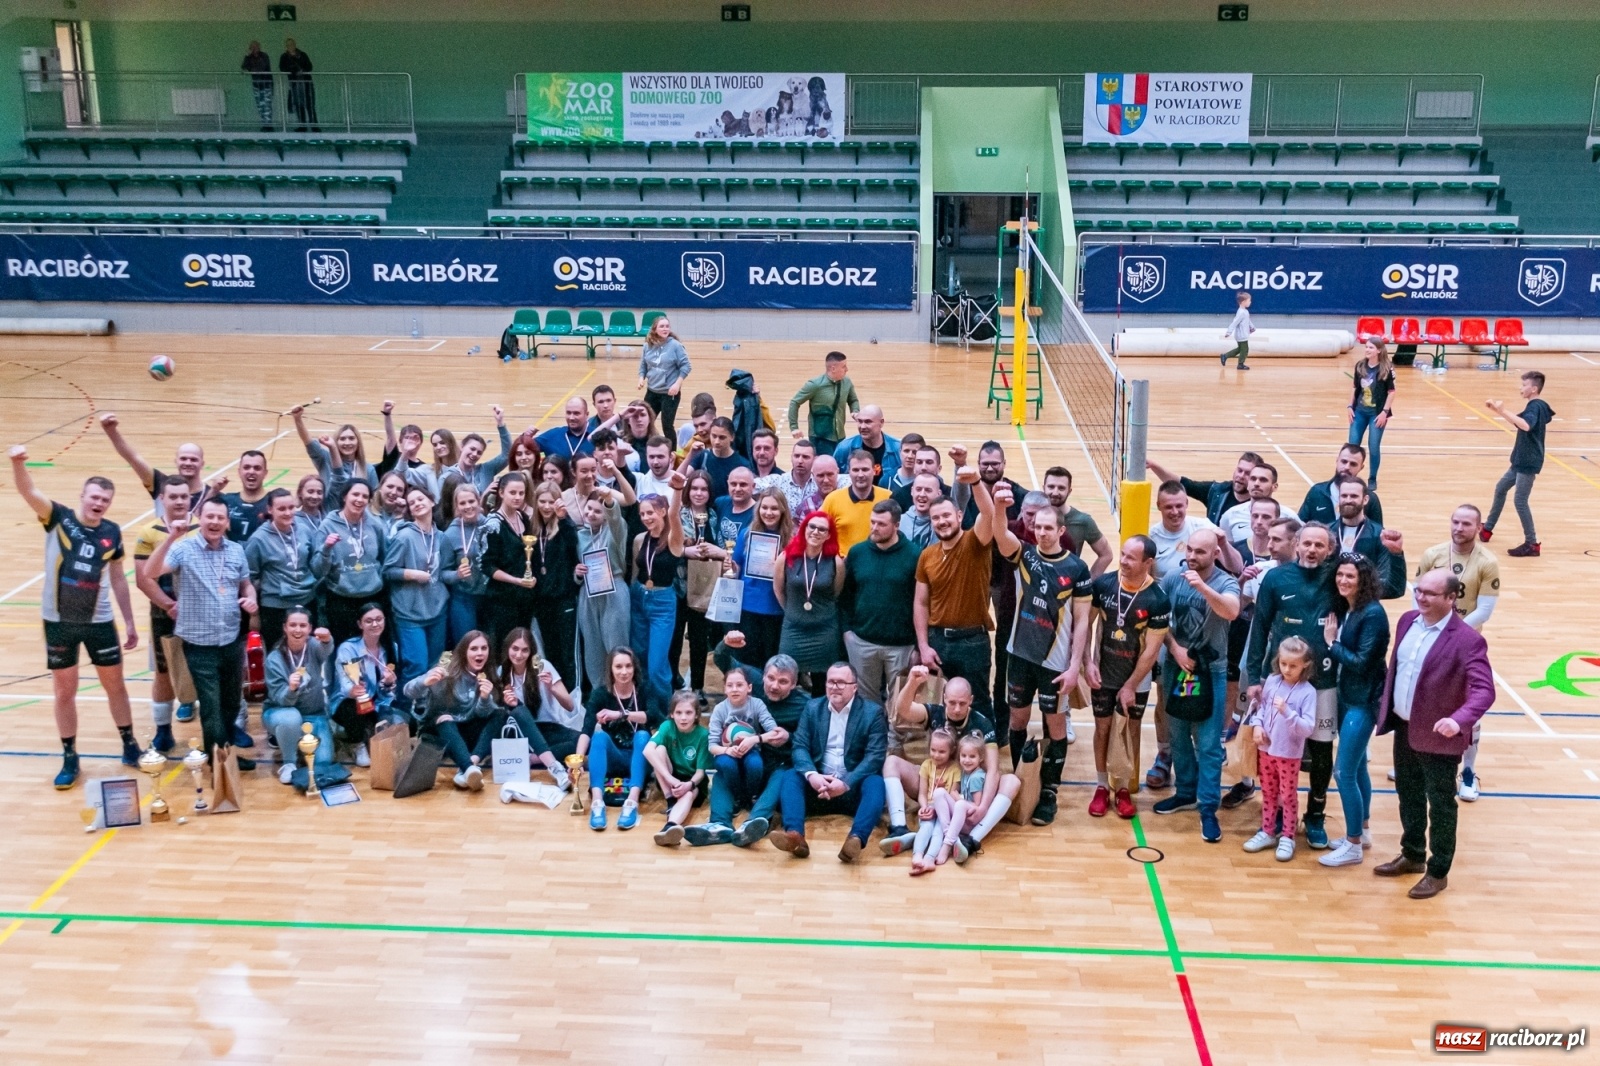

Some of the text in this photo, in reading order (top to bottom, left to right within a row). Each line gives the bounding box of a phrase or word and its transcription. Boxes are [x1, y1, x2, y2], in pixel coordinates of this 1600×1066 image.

[629, 75, 764, 90] WSZYSTKO DLA TWOJEGO
[1155, 81, 1244, 92] STAROSTWO
[566, 82, 614, 99] ZOO
[630, 90, 722, 105] DOMOWEGO ZOO
[564, 98, 614, 115] MAR
[1154, 98, 1242, 110] POWIATOWE
[1154, 115, 1241, 126] W RACIBORZU
[7, 254, 130, 279] RACIBÓRZ
[373, 258, 499, 283] RACIBÓRZ
[749, 261, 877, 287] RACIBÓRZ
[211, 279, 255, 288] RACIBÓRZ
[1190, 264, 1323, 290] RACIBÓRZ
[582, 282, 627, 291] RACIBÓRZ
[1410, 290, 1458, 299] RACIBÓRZ
[79, 542, 95, 558] 10
[1040, 579, 1048, 595] 3
[1322, 657, 1332, 672] 9
[1239, 692, 1247, 702] 6
